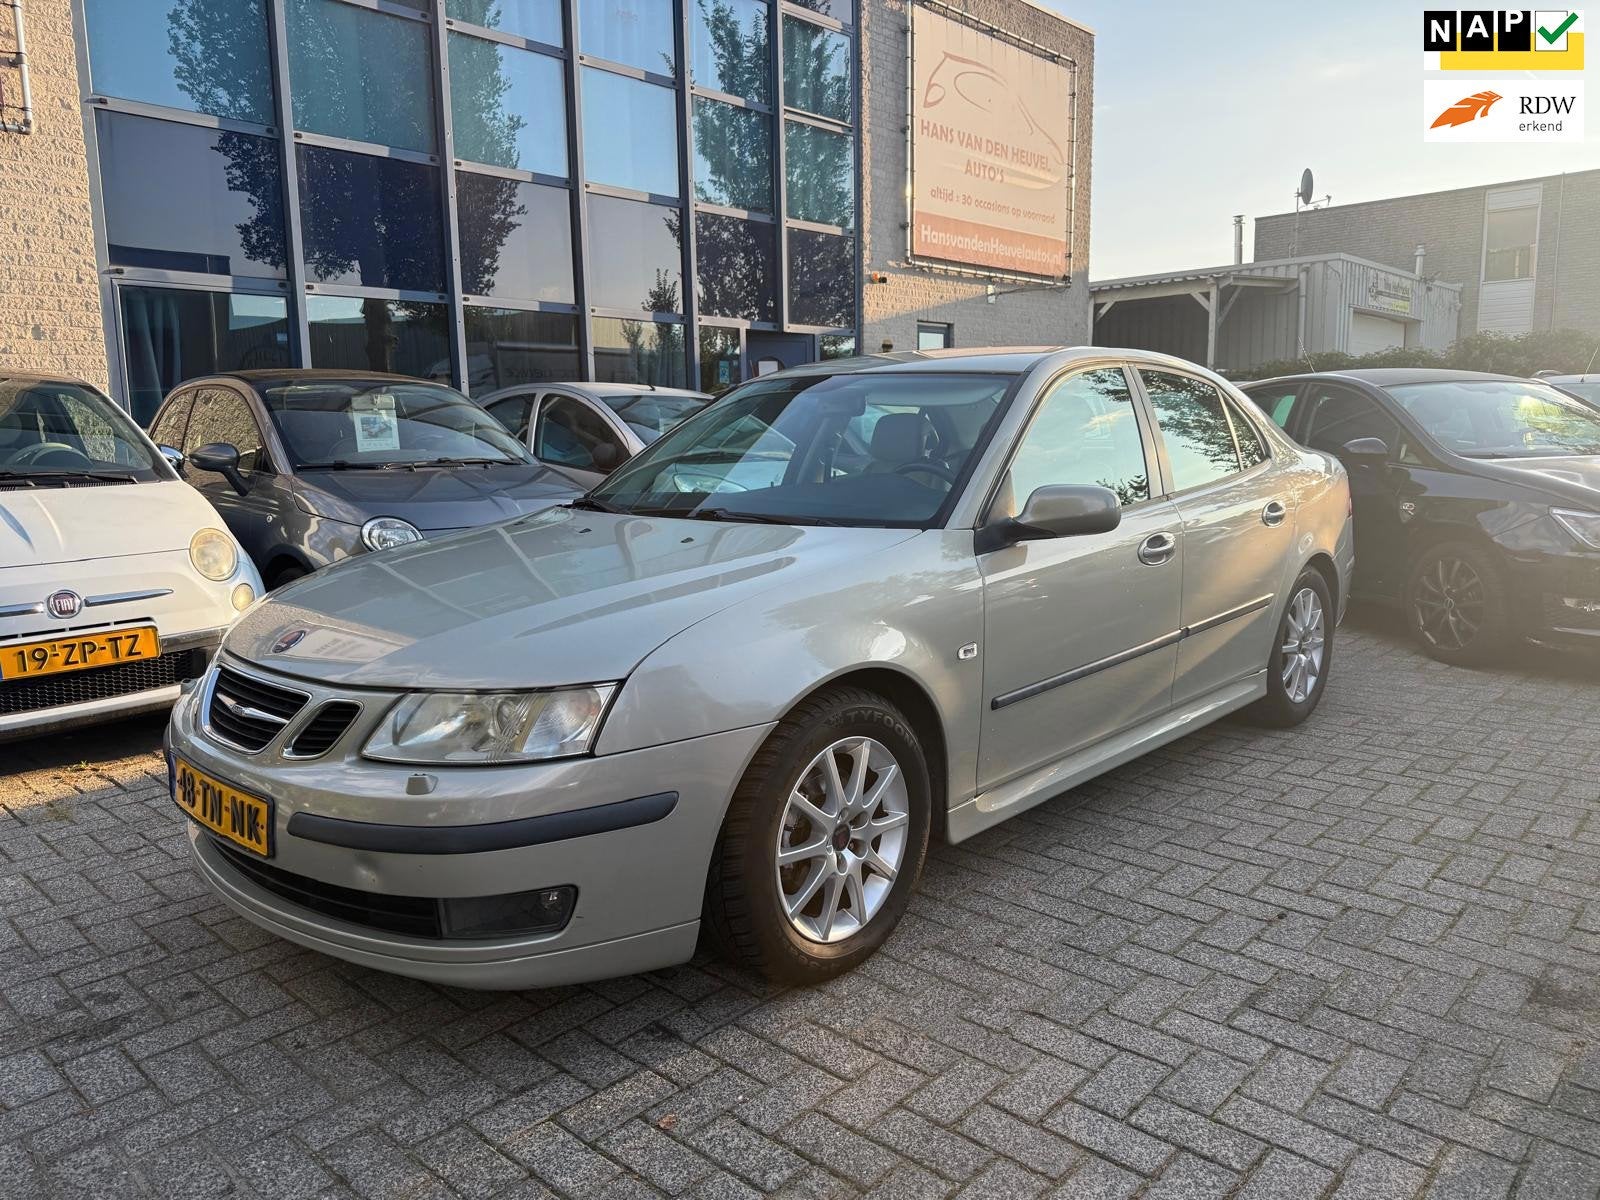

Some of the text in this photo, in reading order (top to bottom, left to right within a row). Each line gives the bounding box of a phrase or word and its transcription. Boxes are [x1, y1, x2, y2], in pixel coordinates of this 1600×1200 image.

[920, 119, 1051, 173] HANS VAN DEN HEUVEL
[964, 159, 1004, 184] AUTO'S
[930, 186, 953, 203] altijd
[961, 193, 972, 206] 30
[974, 199, 1010, 214] occasions
[1011, 206, 1021, 219] op
[920, 223, 1062, 266] HansvandenHeuvelautos.nl
[55, 598, 74, 611] FIAT
[16, 633, 142, 673] 19-ZP-TZ
[846, 710, 914, 748] TYFOON
